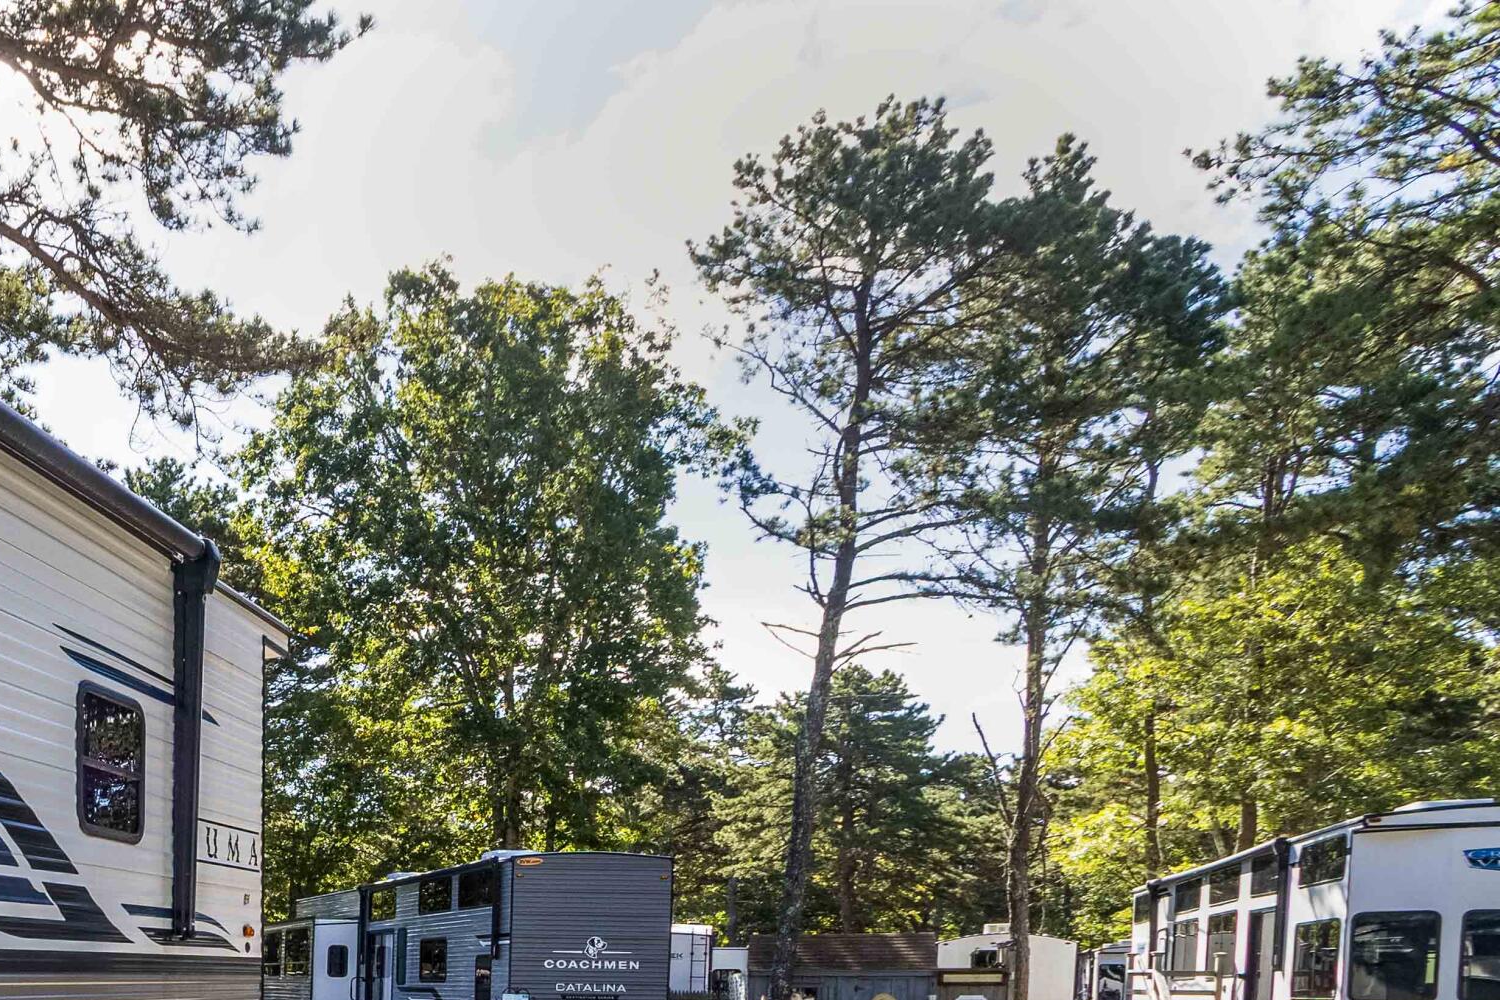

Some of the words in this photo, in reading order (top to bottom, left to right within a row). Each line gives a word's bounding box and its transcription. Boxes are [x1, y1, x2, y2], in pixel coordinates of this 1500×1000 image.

[205, 826, 258, 866] UMA
[543, 959, 640, 970] COACHMEN
[555, 982, 627, 993] CATALINA
